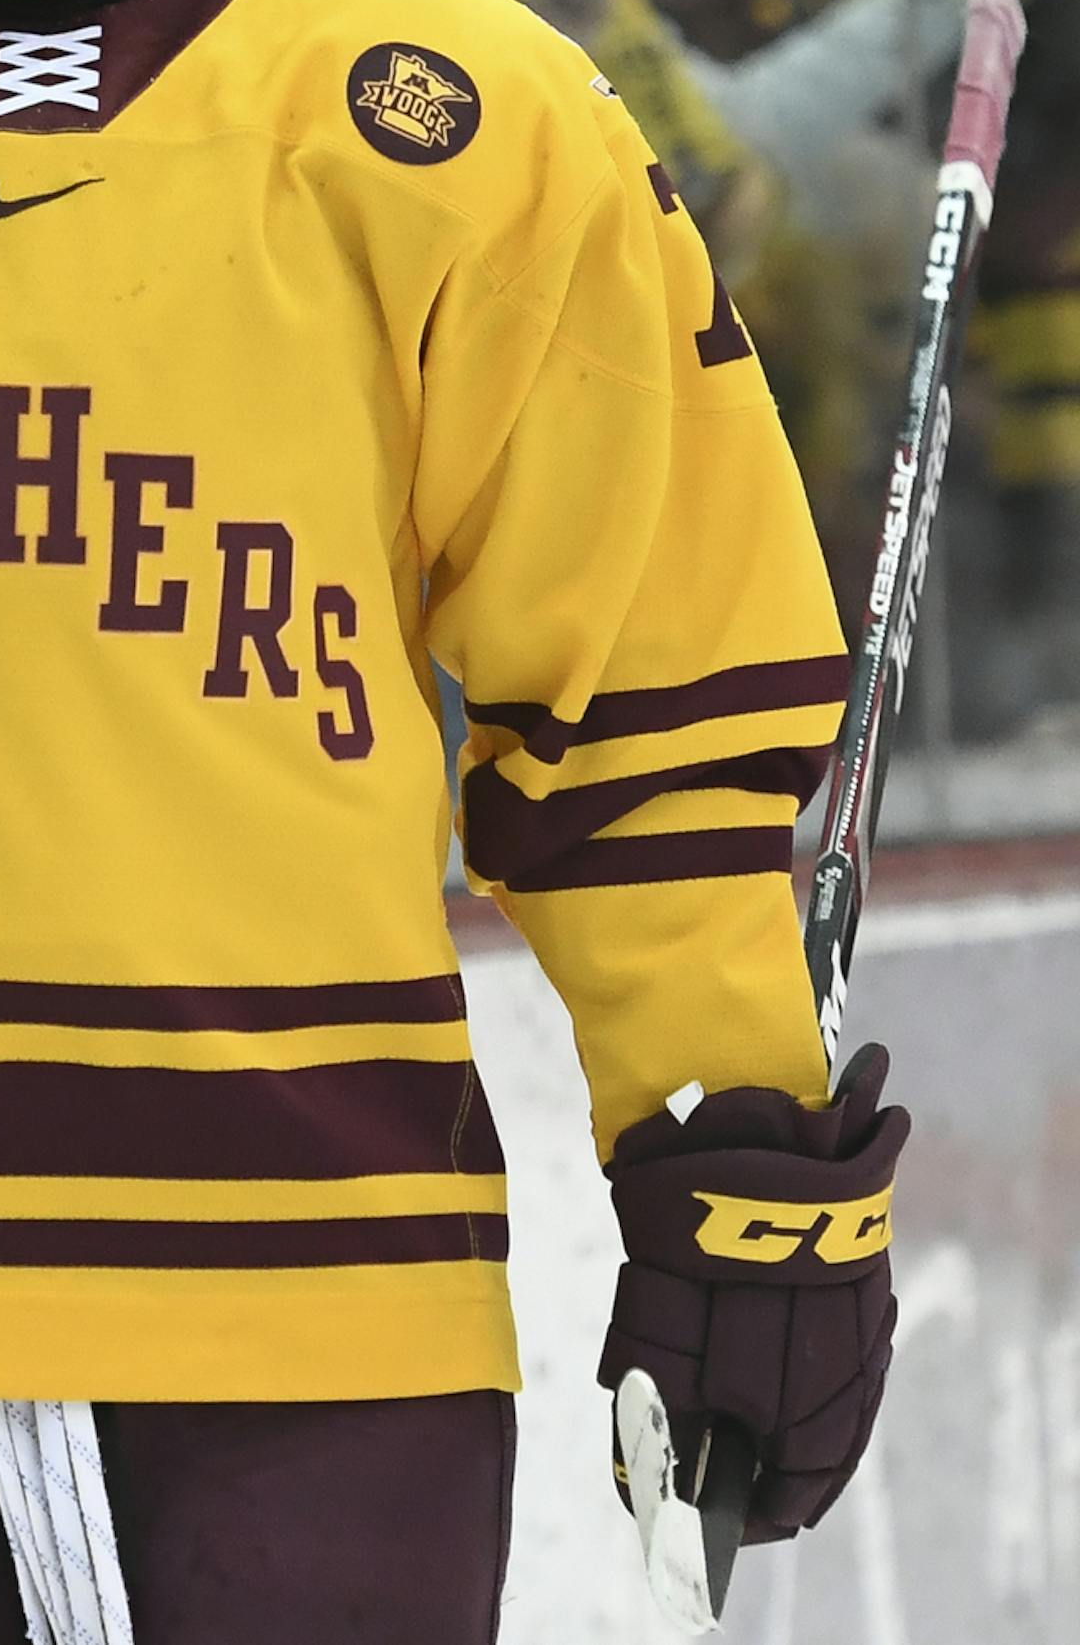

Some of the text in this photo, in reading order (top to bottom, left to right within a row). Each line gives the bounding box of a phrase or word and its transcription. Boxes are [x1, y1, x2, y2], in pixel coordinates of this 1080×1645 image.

[380, 85, 440, 129] WOOG
[921, 192, 967, 302] CCM
[868, 448, 919, 617] JETSPEED
[691, 1179, 895, 1265] CC
